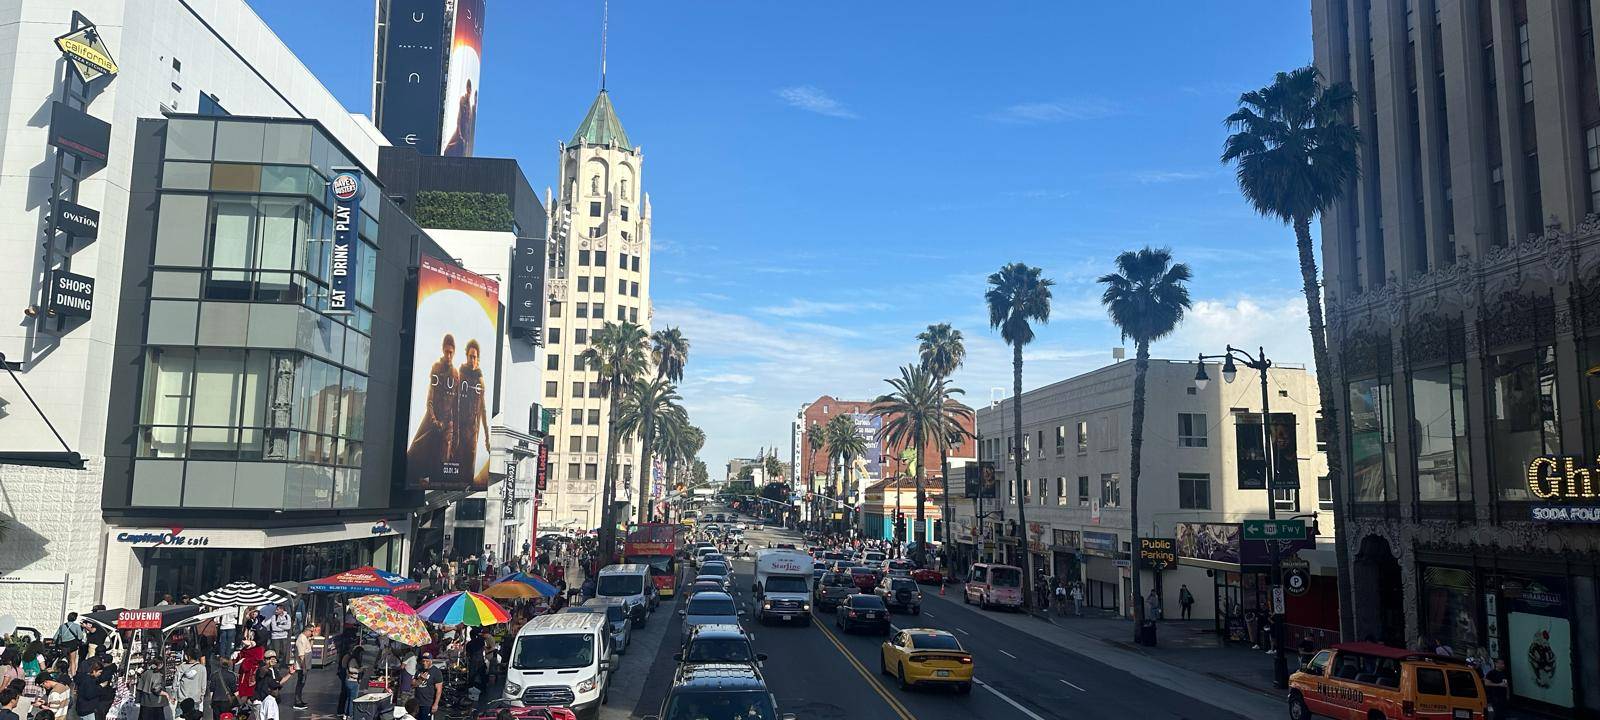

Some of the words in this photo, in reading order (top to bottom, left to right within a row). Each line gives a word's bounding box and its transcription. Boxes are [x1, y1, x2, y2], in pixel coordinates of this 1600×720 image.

[65, 40, 113, 70] california
[335, 206, 351, 231] PLAY
[333, 244, 349, 276] DRINK
[59, 277, 92, 294] SHOPS
[56, 293, 91, 311] DINING
[331, 289, 346, 308] EAT
[1532, 507, 1570, 520] SODA
[1281, 525, 1301, 534] Fwy
[187, 536, 209, 546] café
[1141, 539, 1171, 549] Public
[1141, 550, 1174, 562] Parking
[119, 612, 160, 621] SOUVENIR
